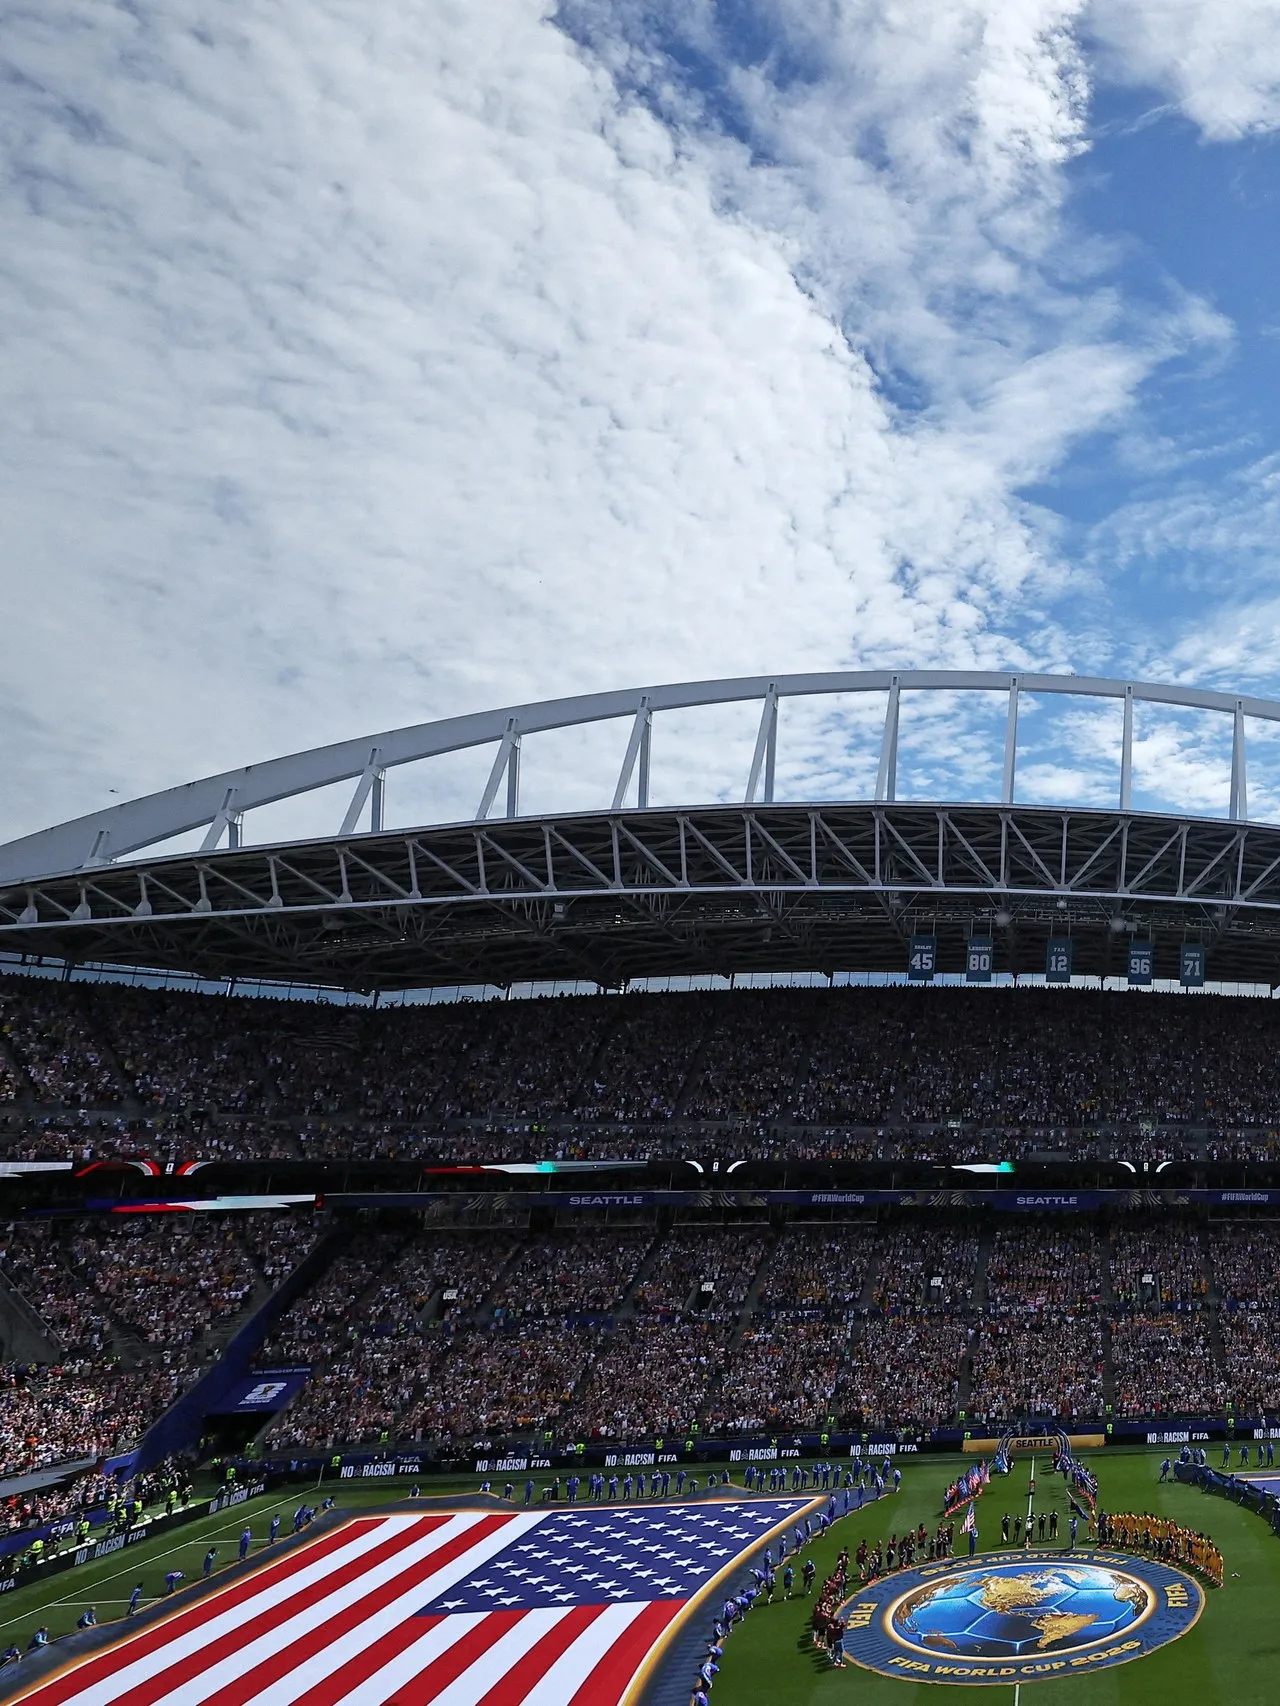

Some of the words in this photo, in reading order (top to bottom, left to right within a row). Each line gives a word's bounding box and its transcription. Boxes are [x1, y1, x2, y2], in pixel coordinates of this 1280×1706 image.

[910, 954, 933, 970] 45
[969, 955, 990, 971] 80
[1050, 956, 1068, 972] 12
[1130, 958, 1150, 974] 96
[1184, 960, 1200, 976] 71
[570, 1196, 642, 1205] SEATTLE
[812, 1194, 864, 1203] #FIFAWorldCup
[1016, 1196, 1078, 1204] SEATTLE
[1222, 1193, 1268, 1202] #FIFAWorldCup
[1147, 1432, 1157, 1444] NO
[1164, 1432, 1189, 1443] RACISM
[1192, 1432, 1209, 1440] FIFA
[1254, 1428, 1266, 1439] NO
[850, 1444, 861, 1456] NO
[868, 1443, 896, 1455] RACISM
[900, 1444, 918, 1452] FIFA
[1016, 1438, 1053, 1448] SEATTLE
[605, 1454, 617, 1467] NO
[625, 1453, 654, 1466] RACISM
[658, 1454, 677, 1463] FIFA
[730, 1449, 742, 1462] NO
[748, 1448, 777, 1460] RACISM
[781, 1449, 800, 1458] FIFA
[340, 1465, 354, 1478] NO
[362, 1463, 395, 1477] RACISM
[399, 1464, 419, 1473] FIFA
[476, 1460, 489, 1472] NO
[496, 1458, 527, 1471] RACISM
[531, 1459, 551, 1468] FIFA
[74, 1548, 87, 1566] NO
[94, 1534, 125, 1558] RACISM
[128, 1529, 146, 1543] FIFA
[986, 1554, 1022, 1564] CUP
[1093, 1556, 1128, 1565] FIFA
[1164, 1582, 1188, 1607] FIFA
[847, 1603, 878, 1629] FIFA
[888, 1657, 930, 1672] FIFA
[934, 1666, 1016, 1677] WORLD
[1020, 1661, 1066, 1674] CUP
[1070, 1640, 1142, 1666] 2026
